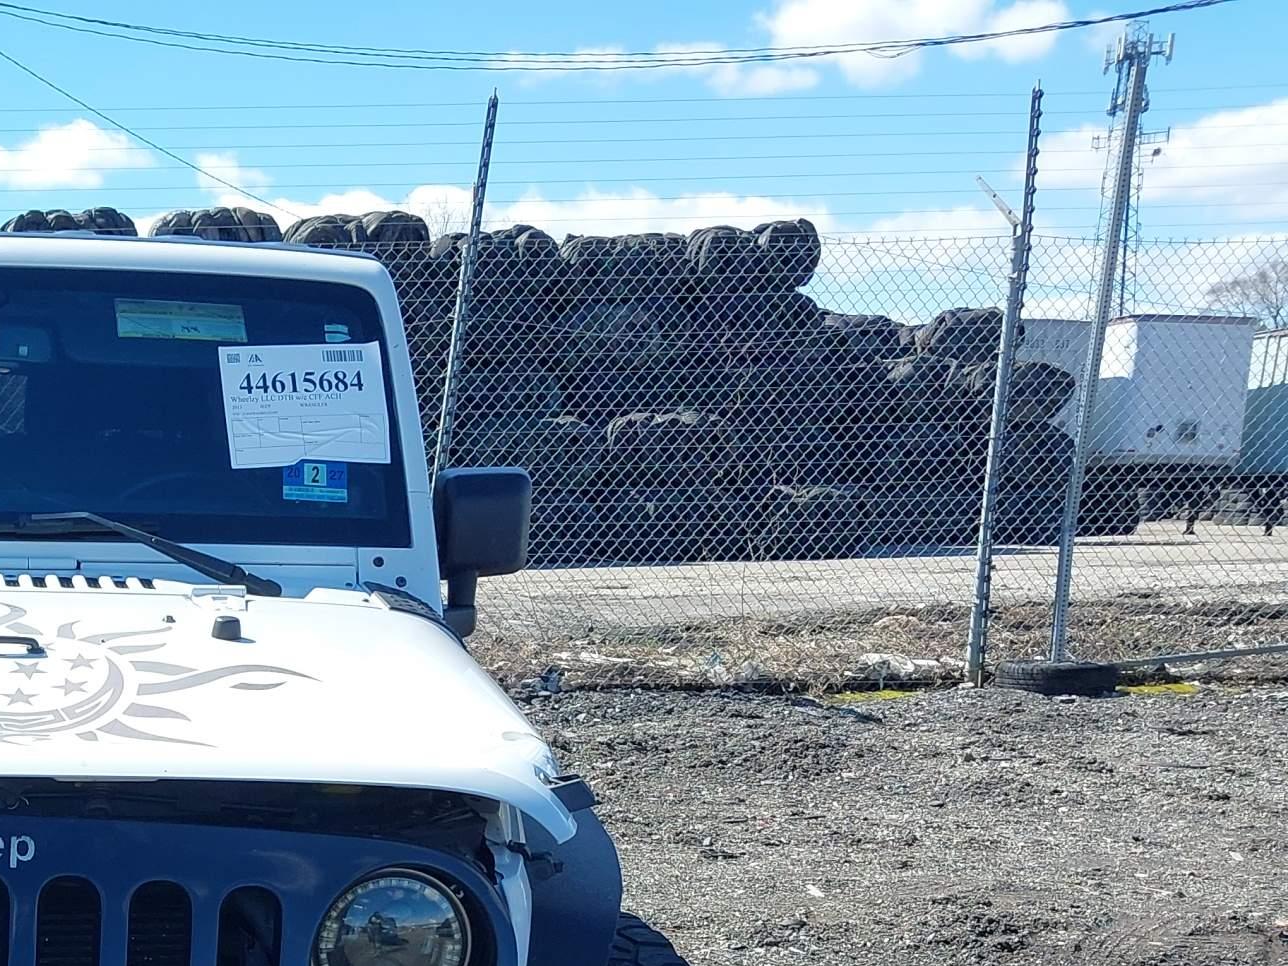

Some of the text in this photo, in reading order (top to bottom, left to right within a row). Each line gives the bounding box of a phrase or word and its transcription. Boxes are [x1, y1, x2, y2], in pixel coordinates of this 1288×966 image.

[239, 370, 364, 395] 44615684
[287, 466, 344, 483] 20 2 27
